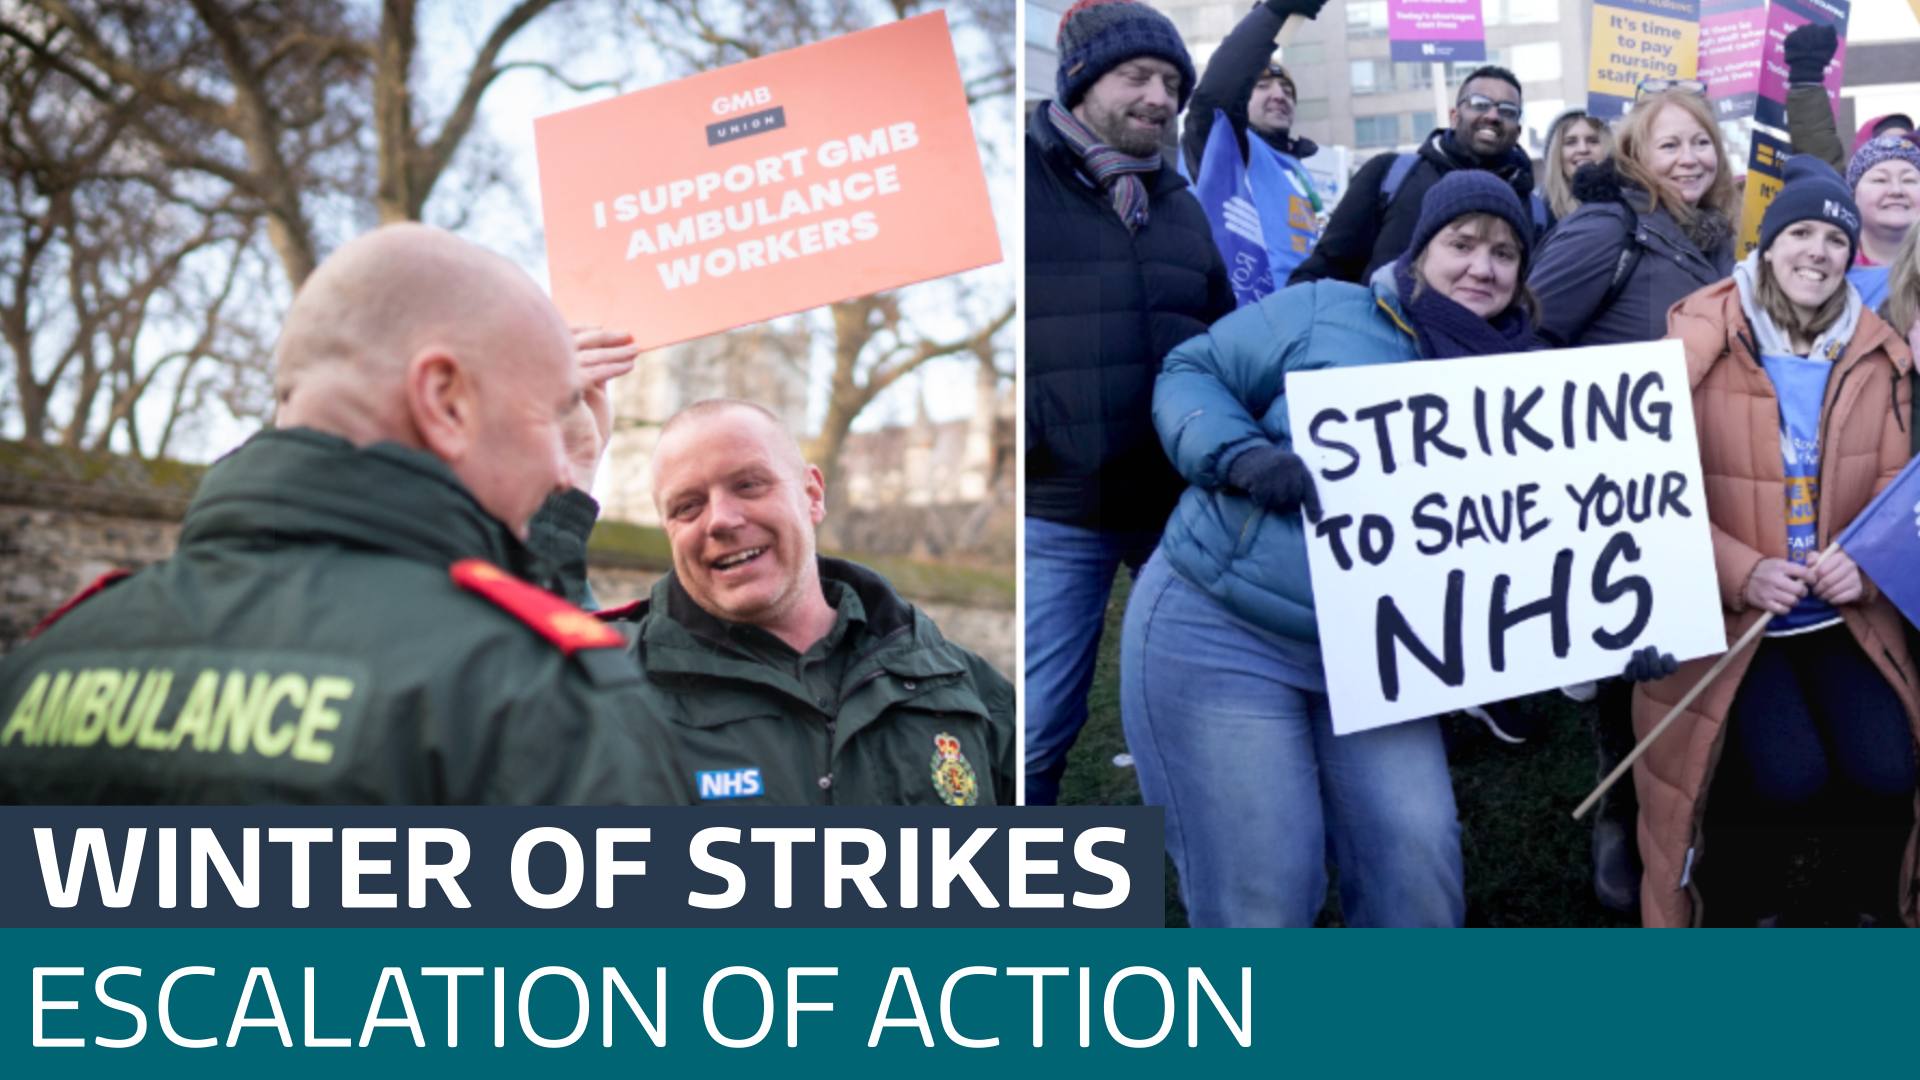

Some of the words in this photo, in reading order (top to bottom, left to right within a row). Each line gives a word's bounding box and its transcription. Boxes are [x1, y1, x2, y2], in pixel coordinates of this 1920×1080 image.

[1611, 15, 1637, 31] It's
[1642, 21, 1682, 40] time
[1618, 34, 1636, 48] to
[1641, 40, 1672, 58] pay
[1597, 68, 1639, 85] staff
[1610, 53, 1678, 77] nursing
[712, 86, 771, 116] GMB
[717, 115, 776, 138] UNION
[593, 201, 607, 229] I
[613, 147, 809, 222] SUPPORT
[817, 121, 919, 169] GMB
[625, 164, 901, 261] AMBULANCE
[656, 211, 879, 291] WORKERS
[1308, 371, 1673, 482] STRIKING
[1316, 513, 1395, 571] TO
[1411, 482, 1553, 555] SAVE
[1565, 471, 1692, 532] YOUR
[1375, 531, 1654, 703] NHS
[0, 667, 355, 764] AMBULANCE
[701, 769, 760, 797] NHS
